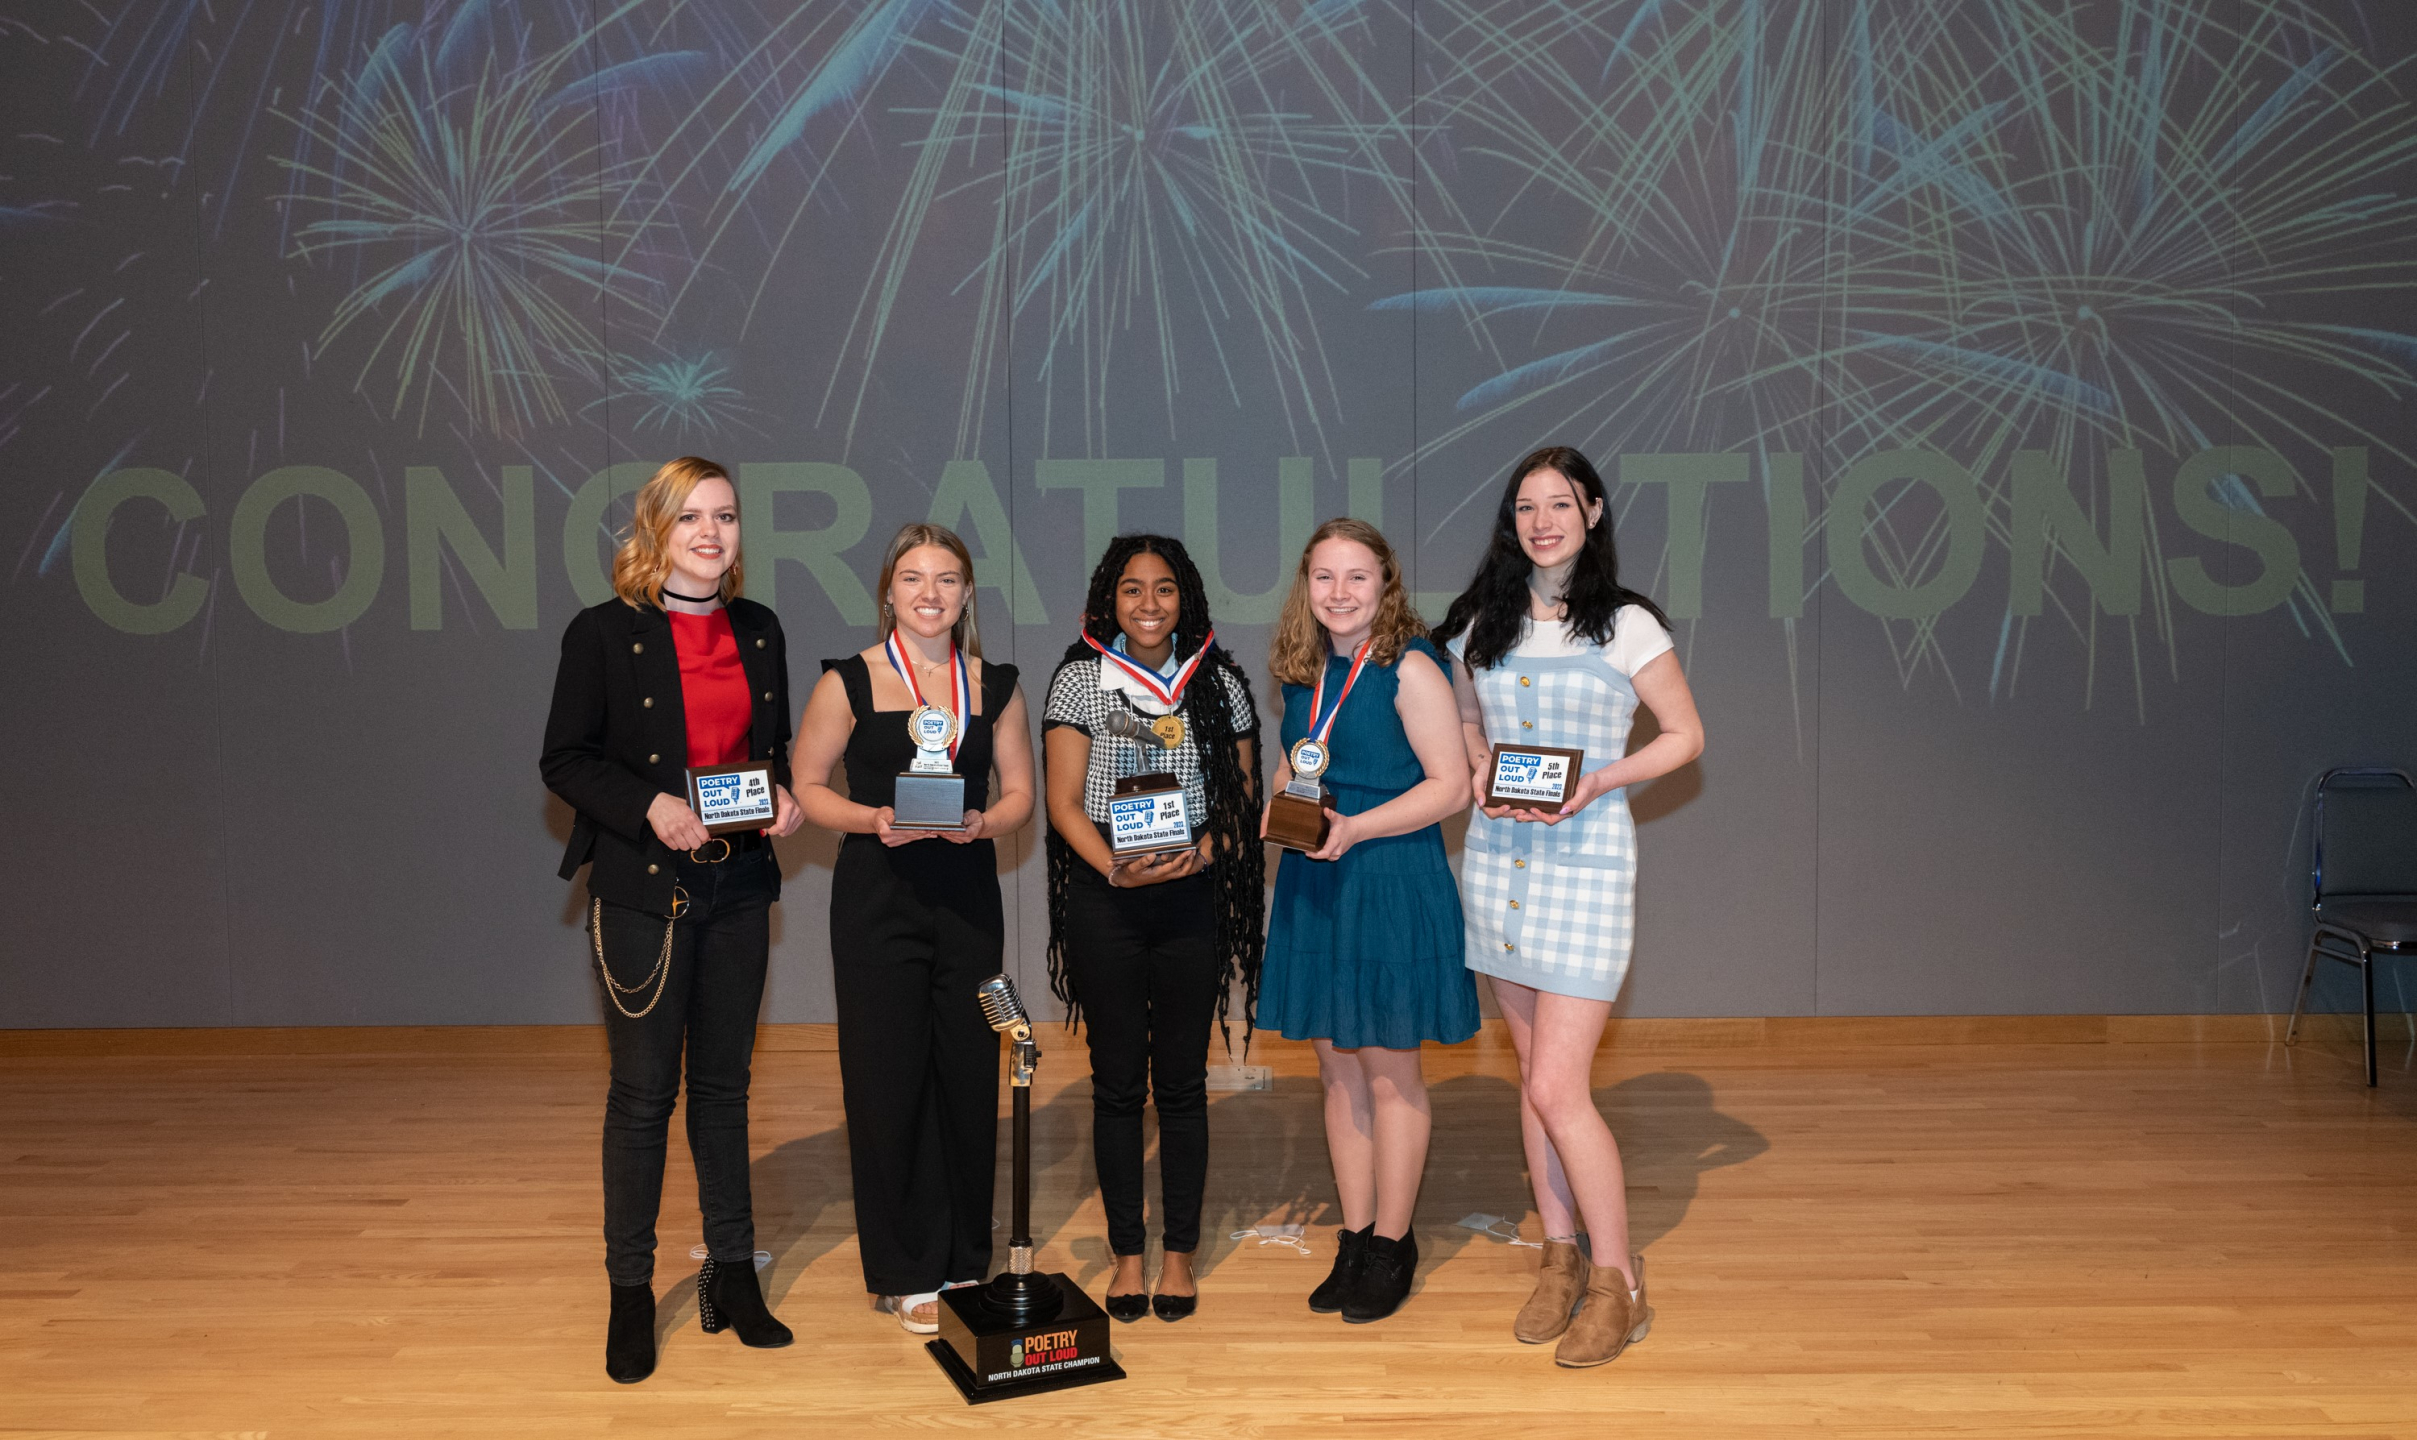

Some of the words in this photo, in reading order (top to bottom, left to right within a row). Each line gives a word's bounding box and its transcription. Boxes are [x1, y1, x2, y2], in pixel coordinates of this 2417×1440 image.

[71, 446, 2368, 634] CONRATULTIONS!
[1502, 755, 1539, 765] POETRY
[1500, 765, 1520, 773] OUT
[1548, 762, 1559, 770] 5th
[1499, 774, 1524, 782] LOUD
[1542, 771, 1562, 779] Place
[701, 776, 738, 787] POETRY
[749, 777, 760, 787] 4th
[703, 789, 722, 798] OUT
[746, 786, 765, 797] Place
[1495, 785, 1510, 793] North
[1530, 788, 1545, 796] State
[704, 798, 730, 807] LOUD
[1114, 800, 1152, 812] POETRY
[1163, 800, 1175, 810] 1st
[704, 811, 720, 820] North
[721, 809, 739, 818] Dakota
[740, 807, 755, 815] State
[755, 806, 770, 814] Finals
[1115, 813, 1136, 822] OUT
[1160, 809, 1180, 820] Place
[1116, 822, 1144, 832] LOUD
[1117, 834, 1133, 844] North
[1134, 832, 1153, 842] Dakota
[1153, 830, 1169, 839] State
[1169, 828, 1185, 837] Finals
[1025, 1329, 1078, 1354] POETRY
[1025, 1352, 1047, 1366] OUT
[1049, 1346, 1078, 1362] LOUD
[988, 1371, 1012, 1381] NORTH
[1012, 1367, 1041, 1377] DAKOTA
[1041, 1362, 1063, 1373] STATE
[1063, 1356, 1100, 1369] CHAMPION
